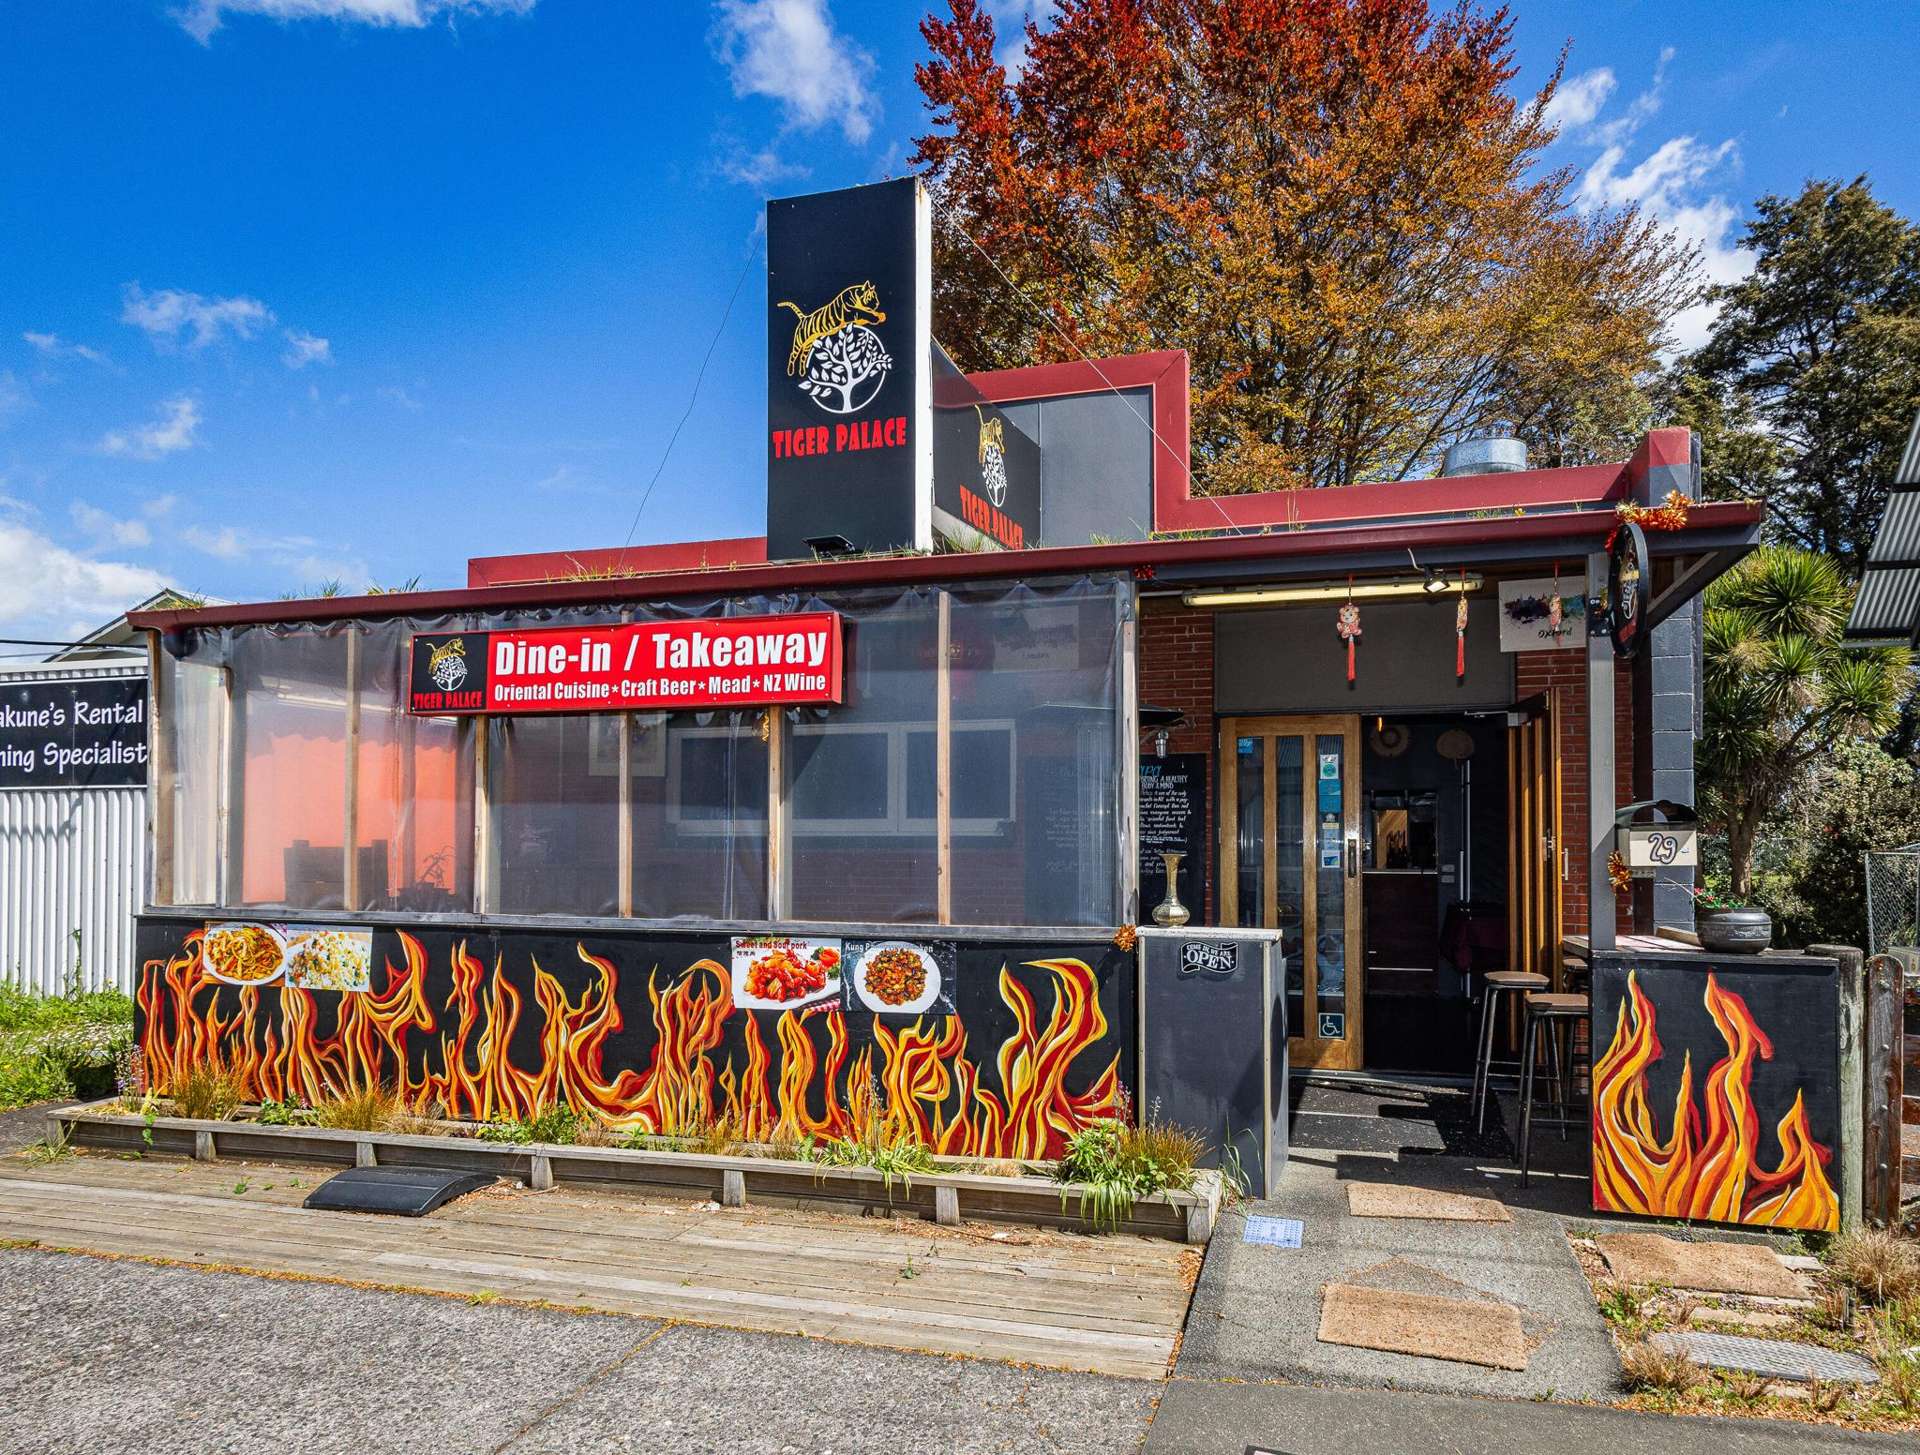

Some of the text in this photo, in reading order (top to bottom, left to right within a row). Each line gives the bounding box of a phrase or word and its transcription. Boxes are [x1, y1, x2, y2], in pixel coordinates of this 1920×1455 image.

[772, 416, 907, 458] TIGER PALACE
[495, 632, 828, 676] Dine-in / Takeaway
[414, 691, 483, 709] TIGER PALACE
[494, 673, 826, 701] Oriental Cuisine Craft Beer Mead NZ Wine
[74, 699, 143, 725] Rental
[43, 740, 147, 774] Specialist
[1648, 833, 1678, 865] 29
[735, 940, 807, 950] Sweet and Sour pork
[845, 942, 864, 953] Kung
[1186, 949, 1232, 969] OPEN
